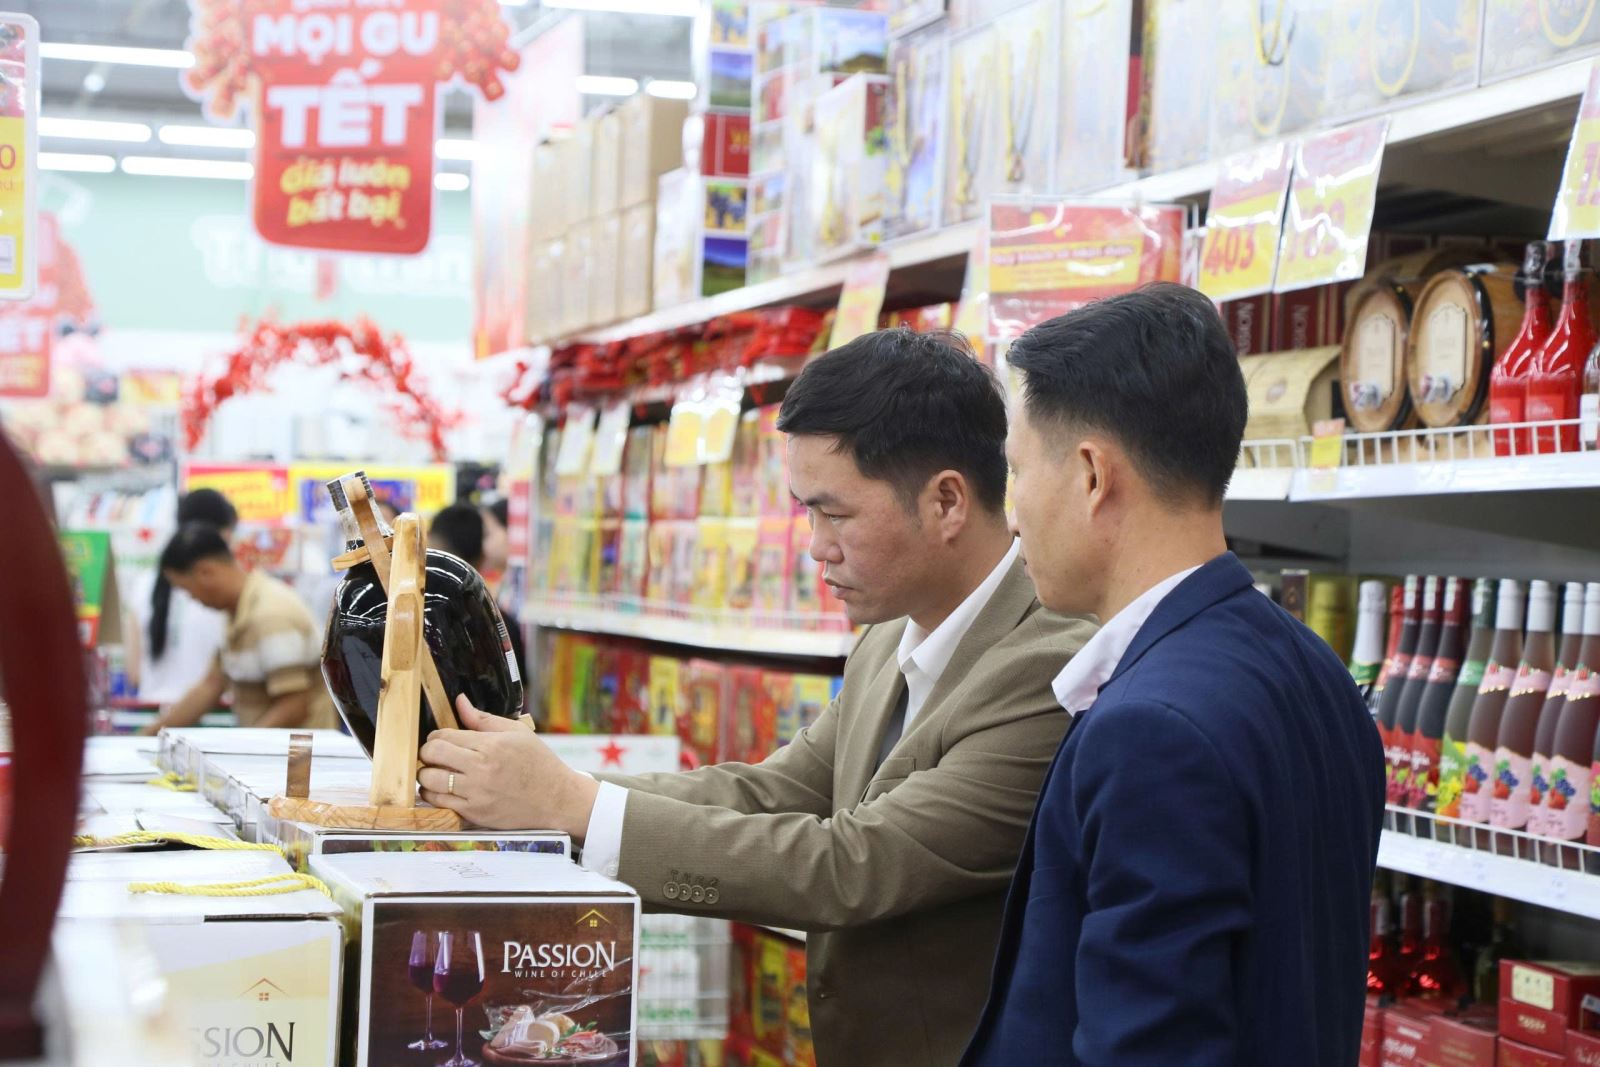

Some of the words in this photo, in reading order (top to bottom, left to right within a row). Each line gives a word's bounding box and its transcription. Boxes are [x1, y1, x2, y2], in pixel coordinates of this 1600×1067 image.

[252, 13, 353, 65] MỌI
[360, 11, 440, 55] GU
[267, 58, 424, 148] TẾT
[501, 941, 616, 972] PASSION
[514, 969, 545, 978] WINE
[551, 969, 565, 978] OF
[571, 969, 607, 978] CHILE
